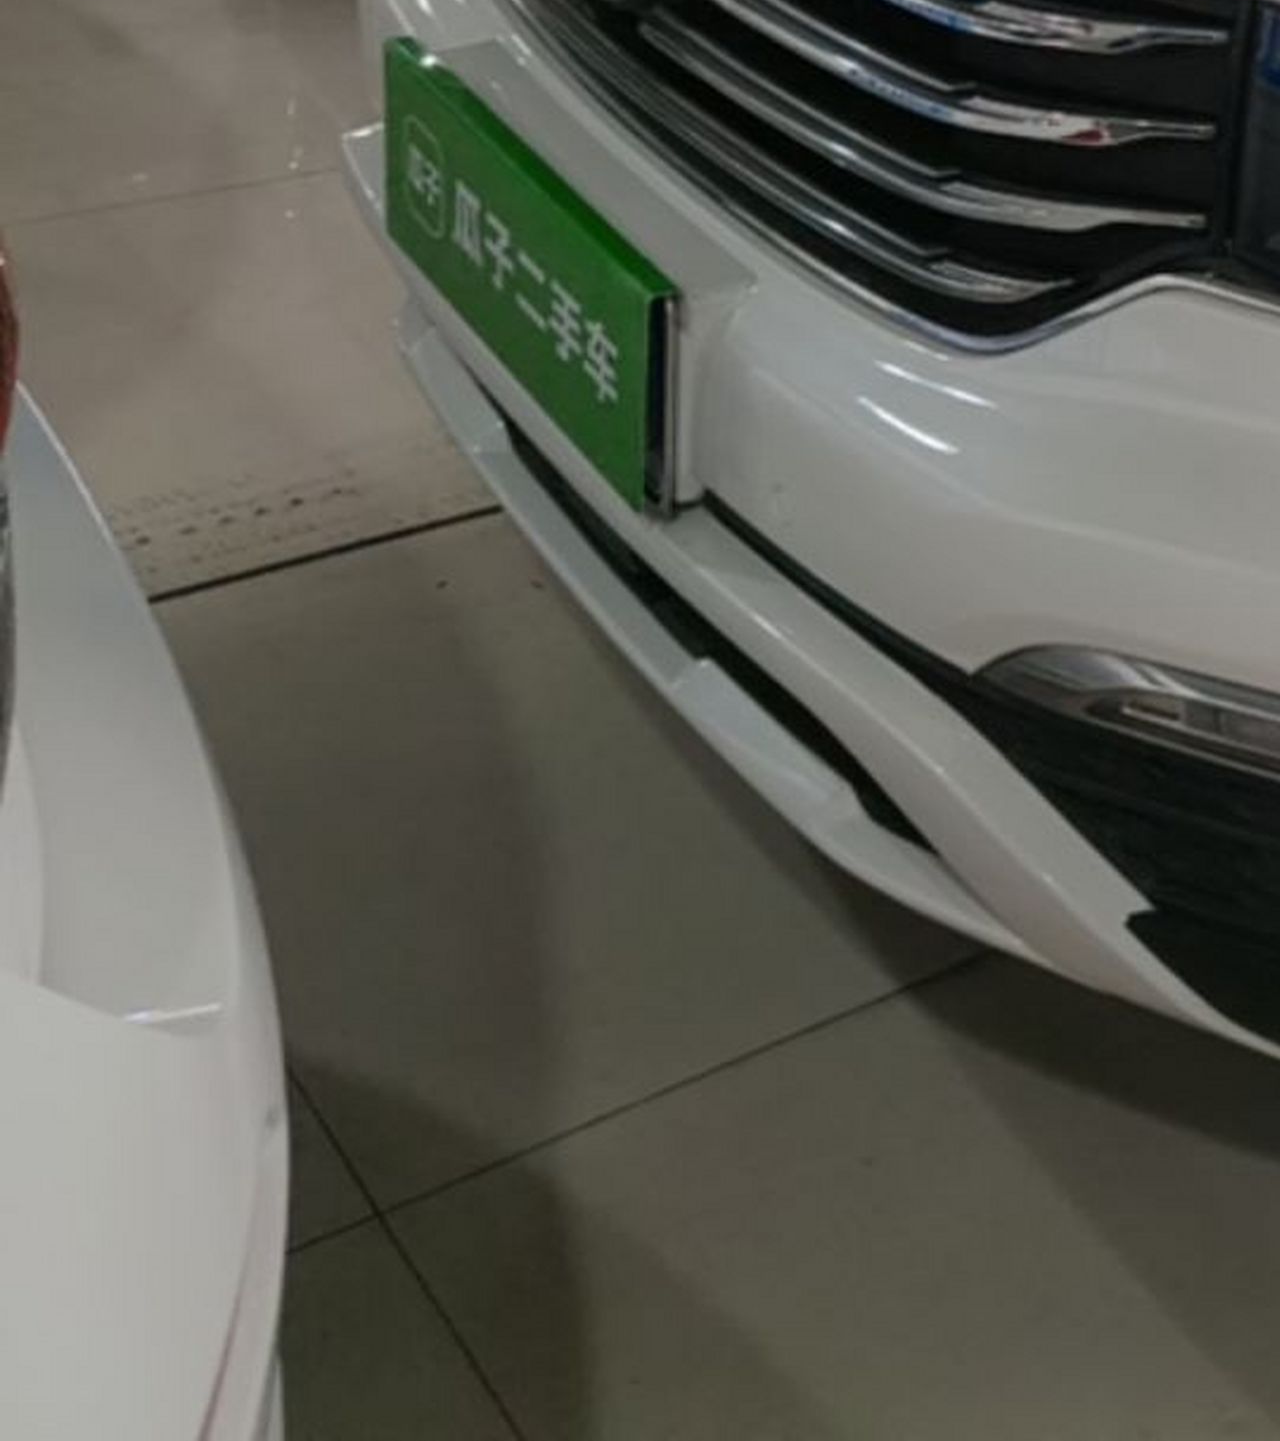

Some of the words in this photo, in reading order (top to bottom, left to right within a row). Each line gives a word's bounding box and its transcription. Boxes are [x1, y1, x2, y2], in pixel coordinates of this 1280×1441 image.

[453, 178, 619, 402] 瓜子二手车
